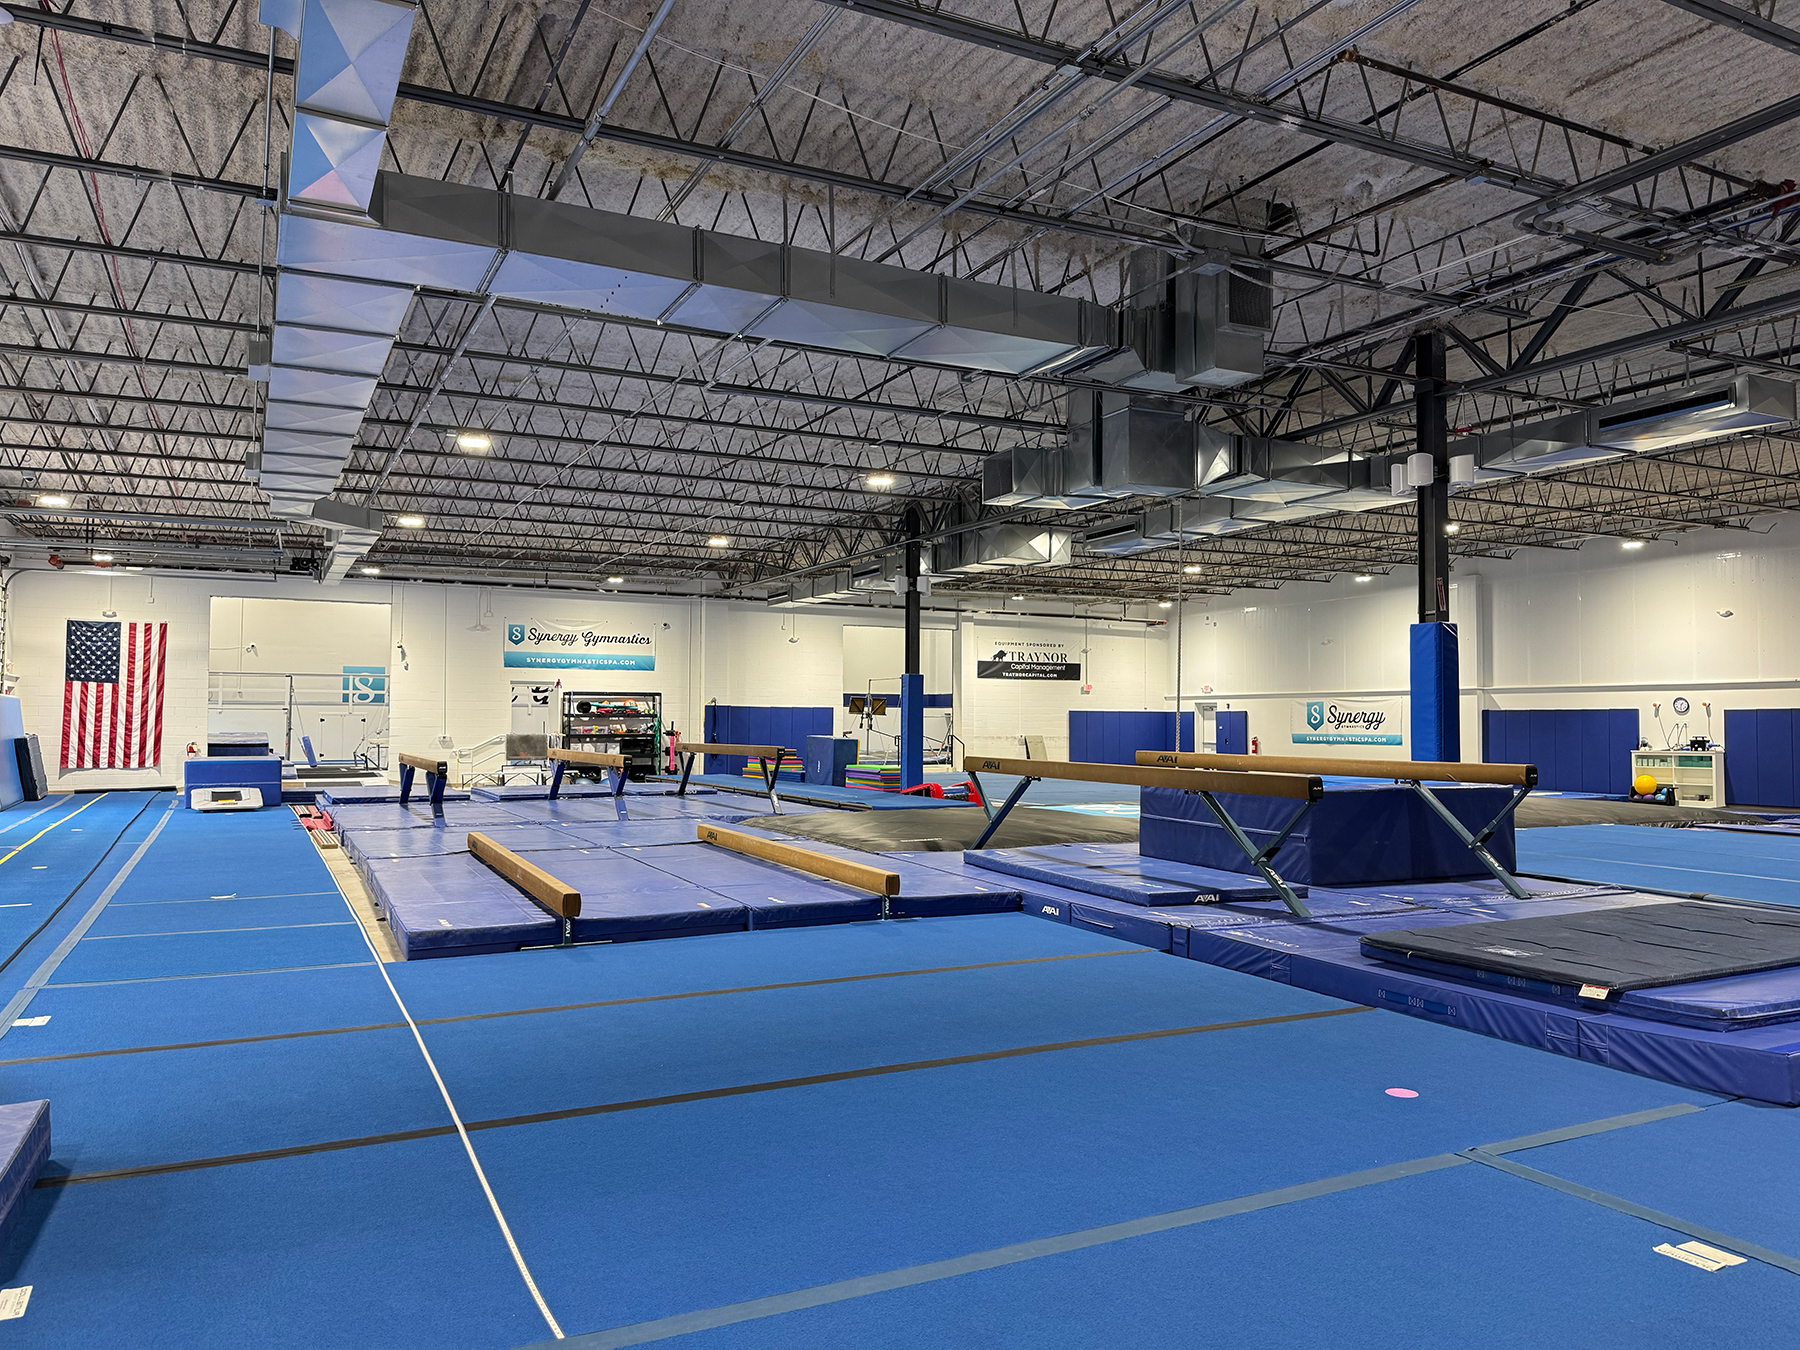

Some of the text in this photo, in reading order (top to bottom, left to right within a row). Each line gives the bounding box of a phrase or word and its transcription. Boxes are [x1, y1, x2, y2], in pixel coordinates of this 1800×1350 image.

[527, 627, 652, 647] Synergy Gymnastics
[526, 657, 636, 666] SYNERGYGYMNASTICSPA.COM
[1009, 651, 1068, 663] TRAYNOR
[1010, 663, 1066, 672] Capital Management
[1327, 705, 1386, 730] Synergy
